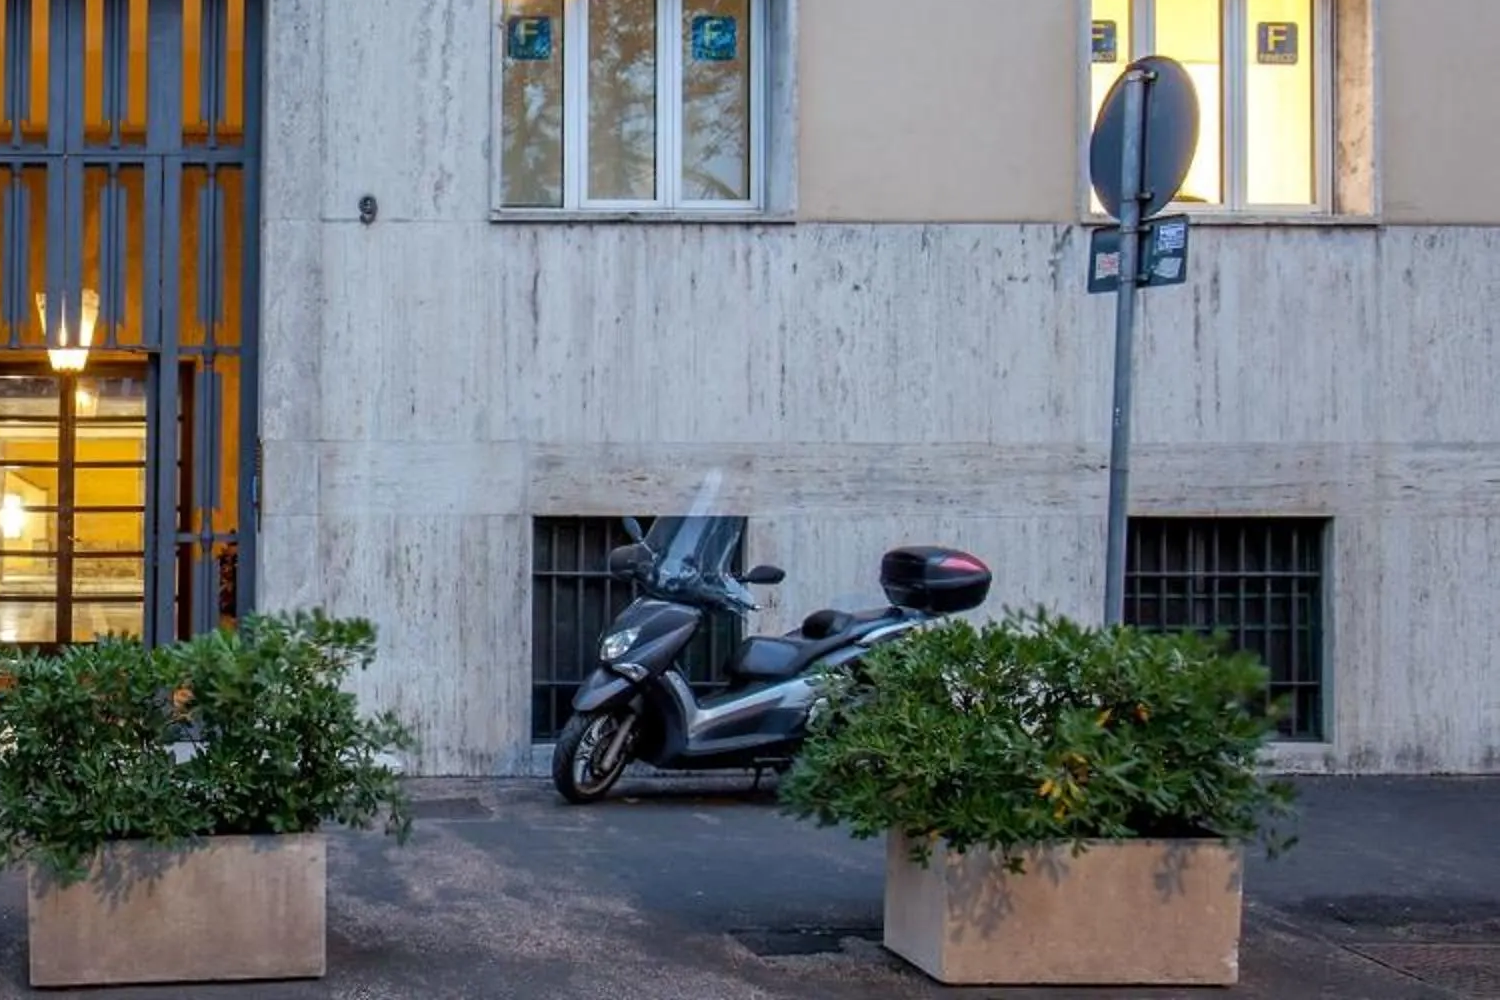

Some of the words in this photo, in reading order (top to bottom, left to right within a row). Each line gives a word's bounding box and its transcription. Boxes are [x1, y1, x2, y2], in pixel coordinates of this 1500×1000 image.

[518, 19, 539, 46] F
[704, 20, 724, 47] F
[1267, 25, 1287, 51] F
[358, 196, 378, 225] 9
